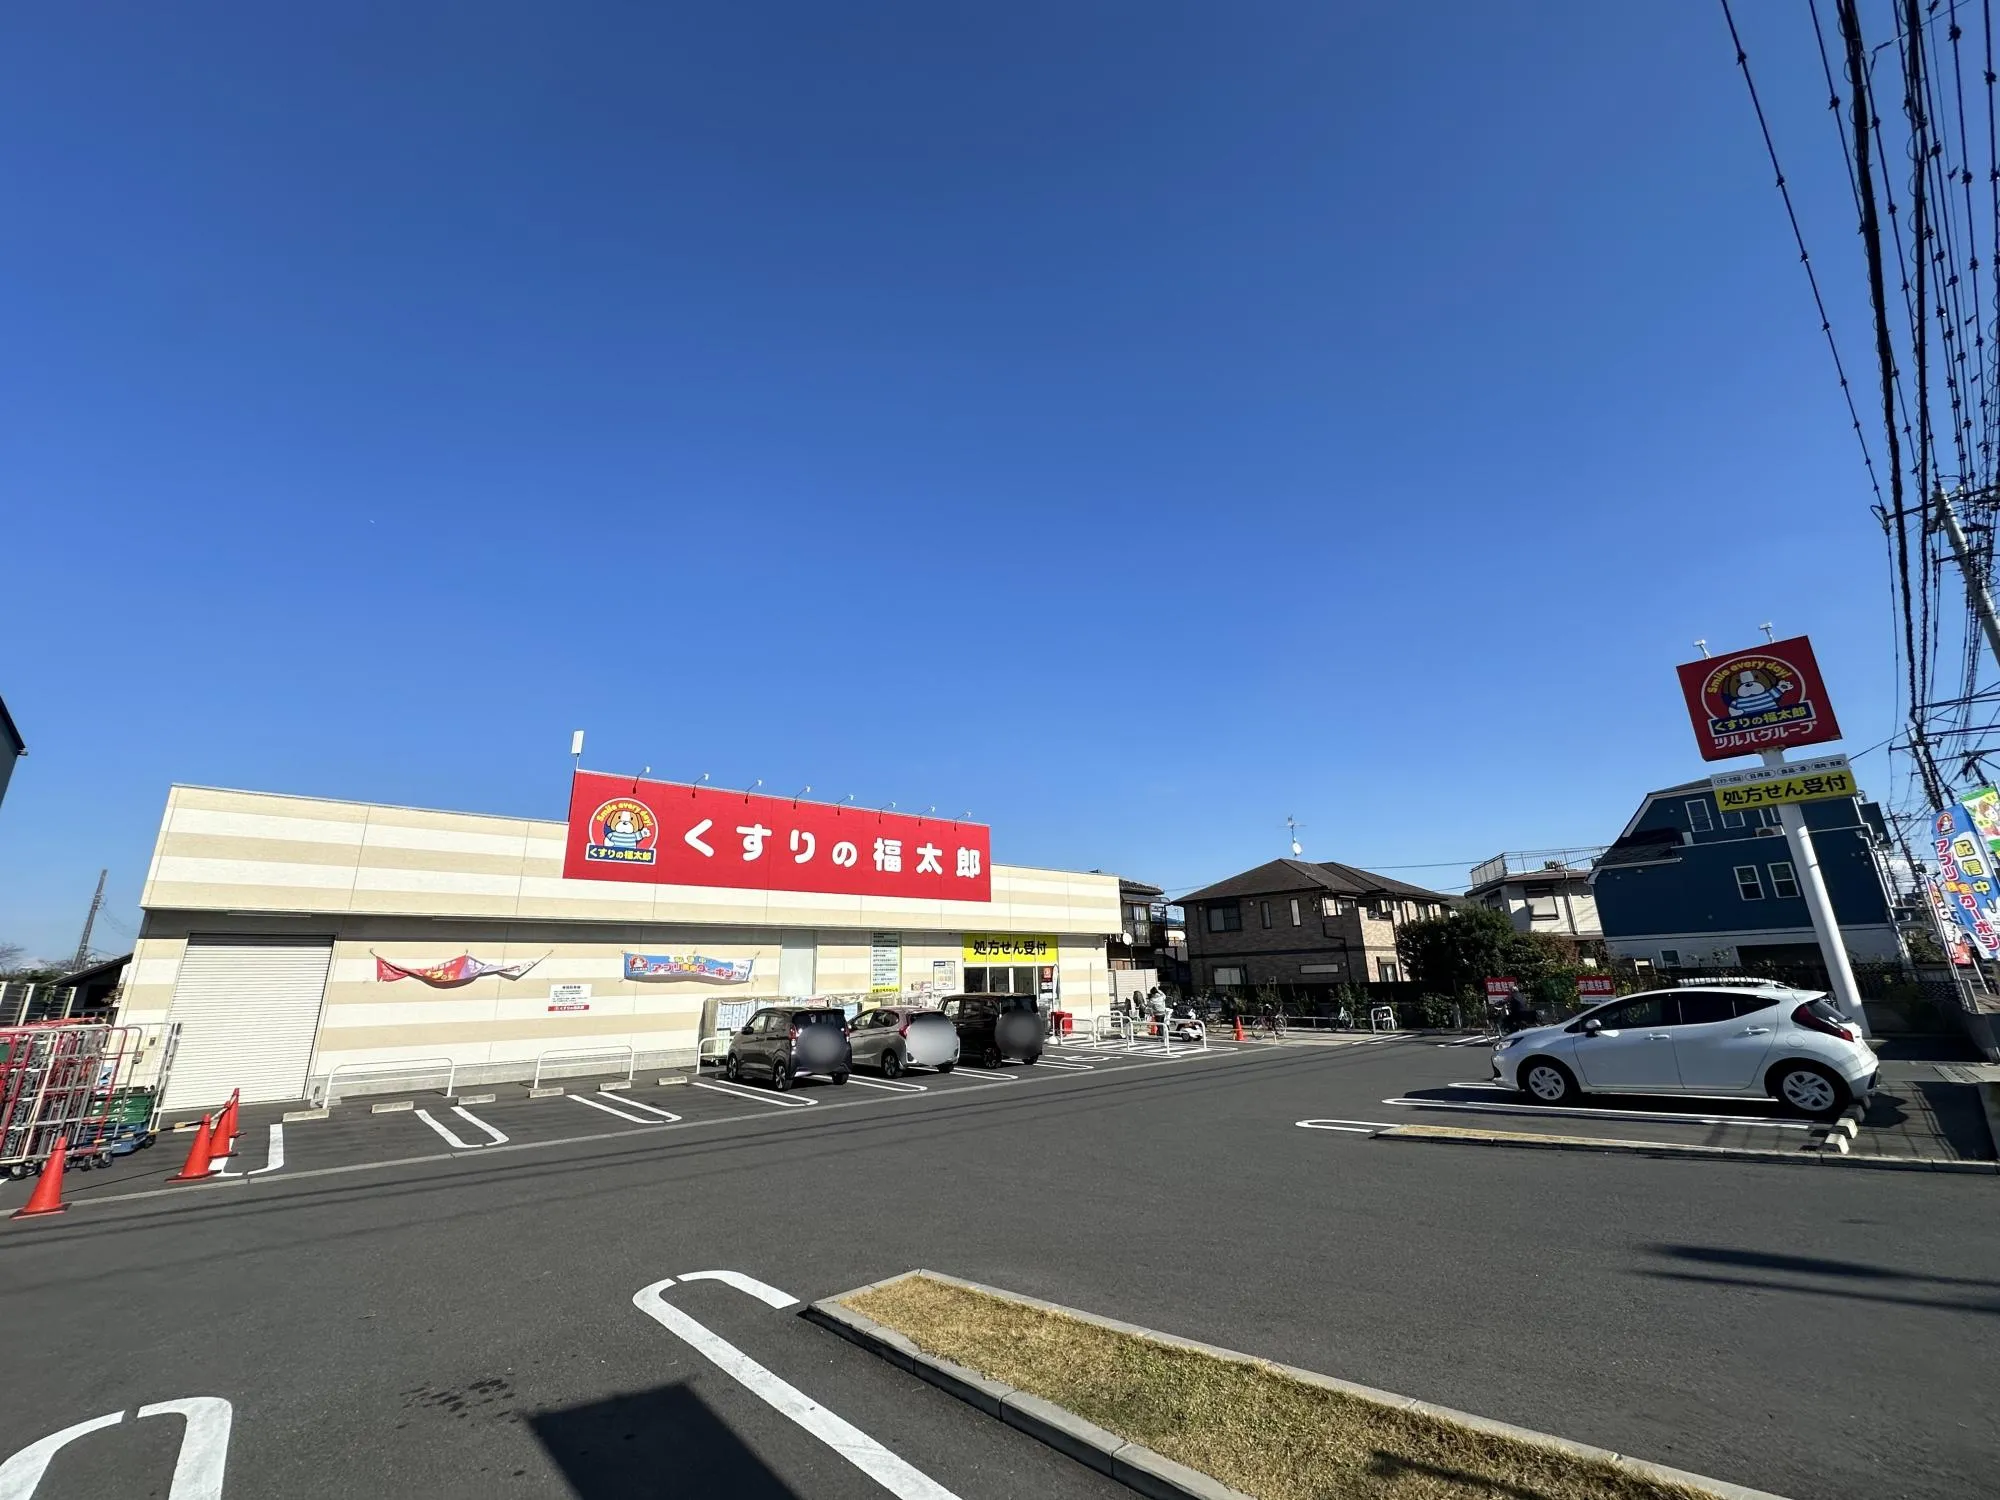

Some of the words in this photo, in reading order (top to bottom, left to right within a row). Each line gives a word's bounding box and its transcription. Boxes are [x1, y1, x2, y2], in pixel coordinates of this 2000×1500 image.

[1707, 668, 1730, 694] Smile
[1731, 660, 1765, 672] every
[1766, 661, 1792, 678] day!
[1713, 706, 1807, 731] くすりの福太郎
[1714, 720, 1818, 750] ツルハグループ
[1722, 774, 1847, 806] 処方せん受付
[596, 803, 618, 822] Smile
[590, 847, 652, 861] くすりの福太郎
[684, 818, 980, 879] くすりの福太郎
[974, 940, 1047, 956] 処方せん受付
